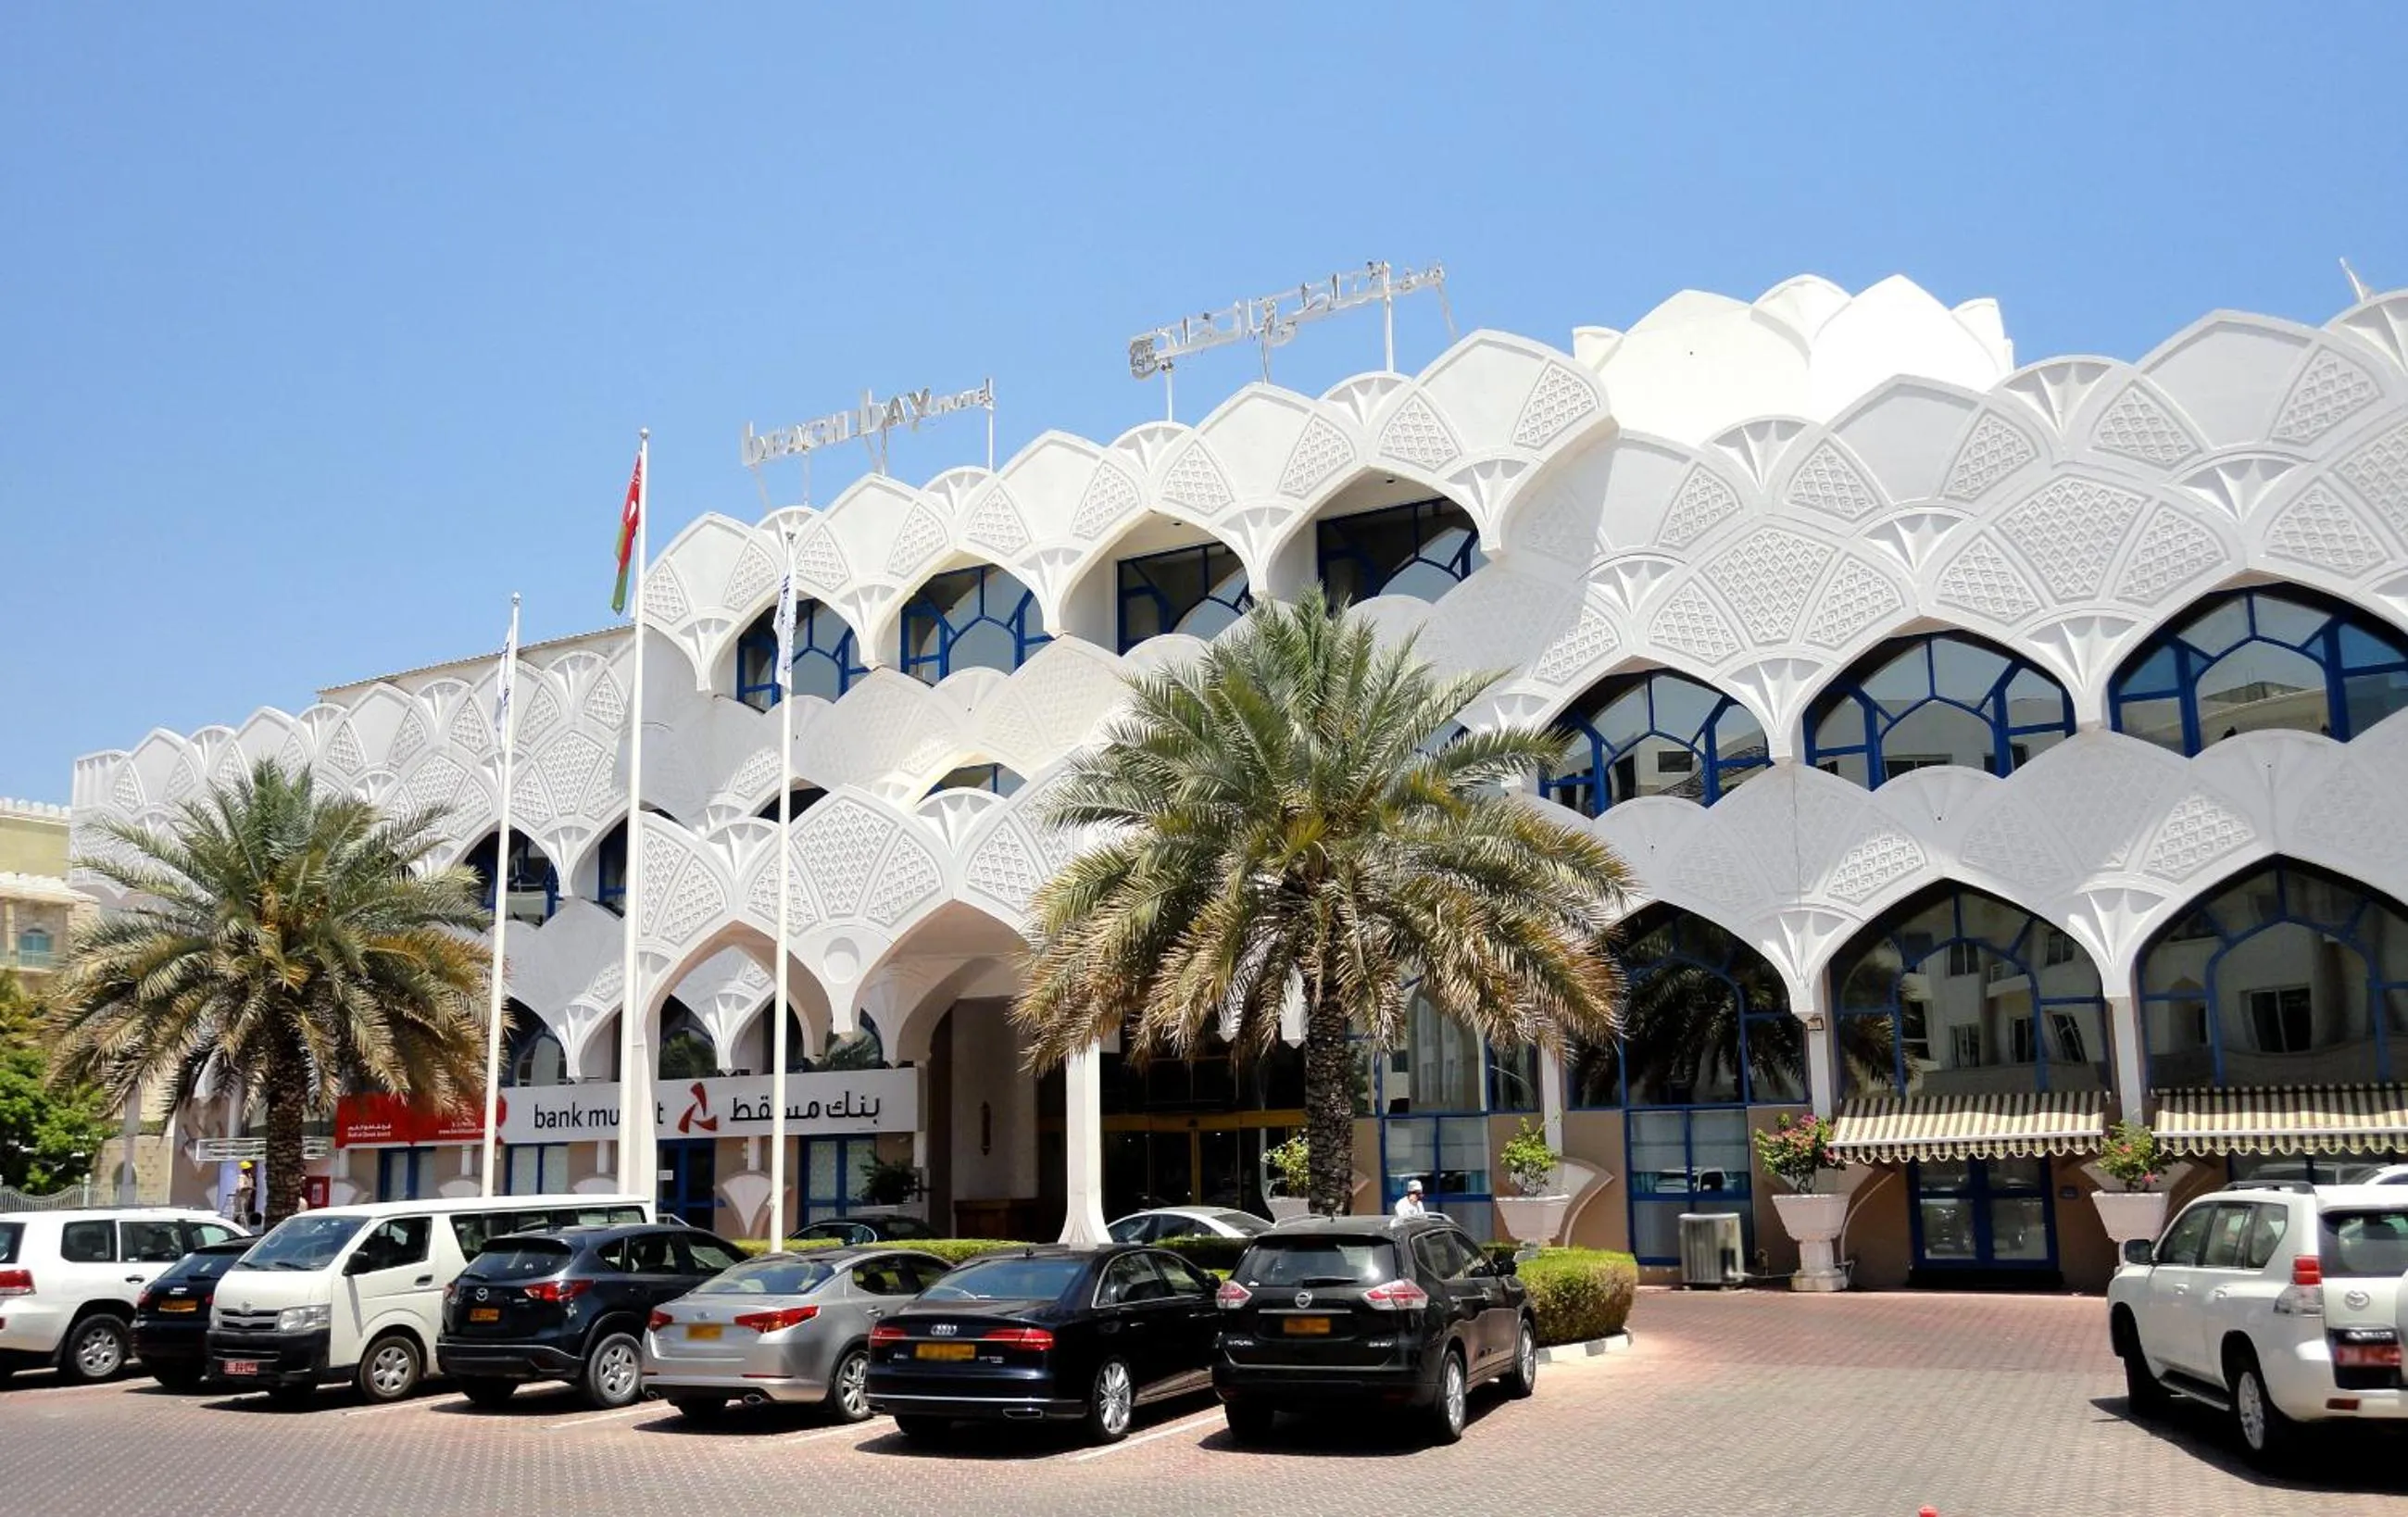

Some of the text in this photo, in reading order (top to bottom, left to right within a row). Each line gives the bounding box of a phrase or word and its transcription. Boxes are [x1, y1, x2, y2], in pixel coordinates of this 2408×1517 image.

[533, 1101, 664, 1129] bank mut
[825, 1090, 880, 1124] بنك
